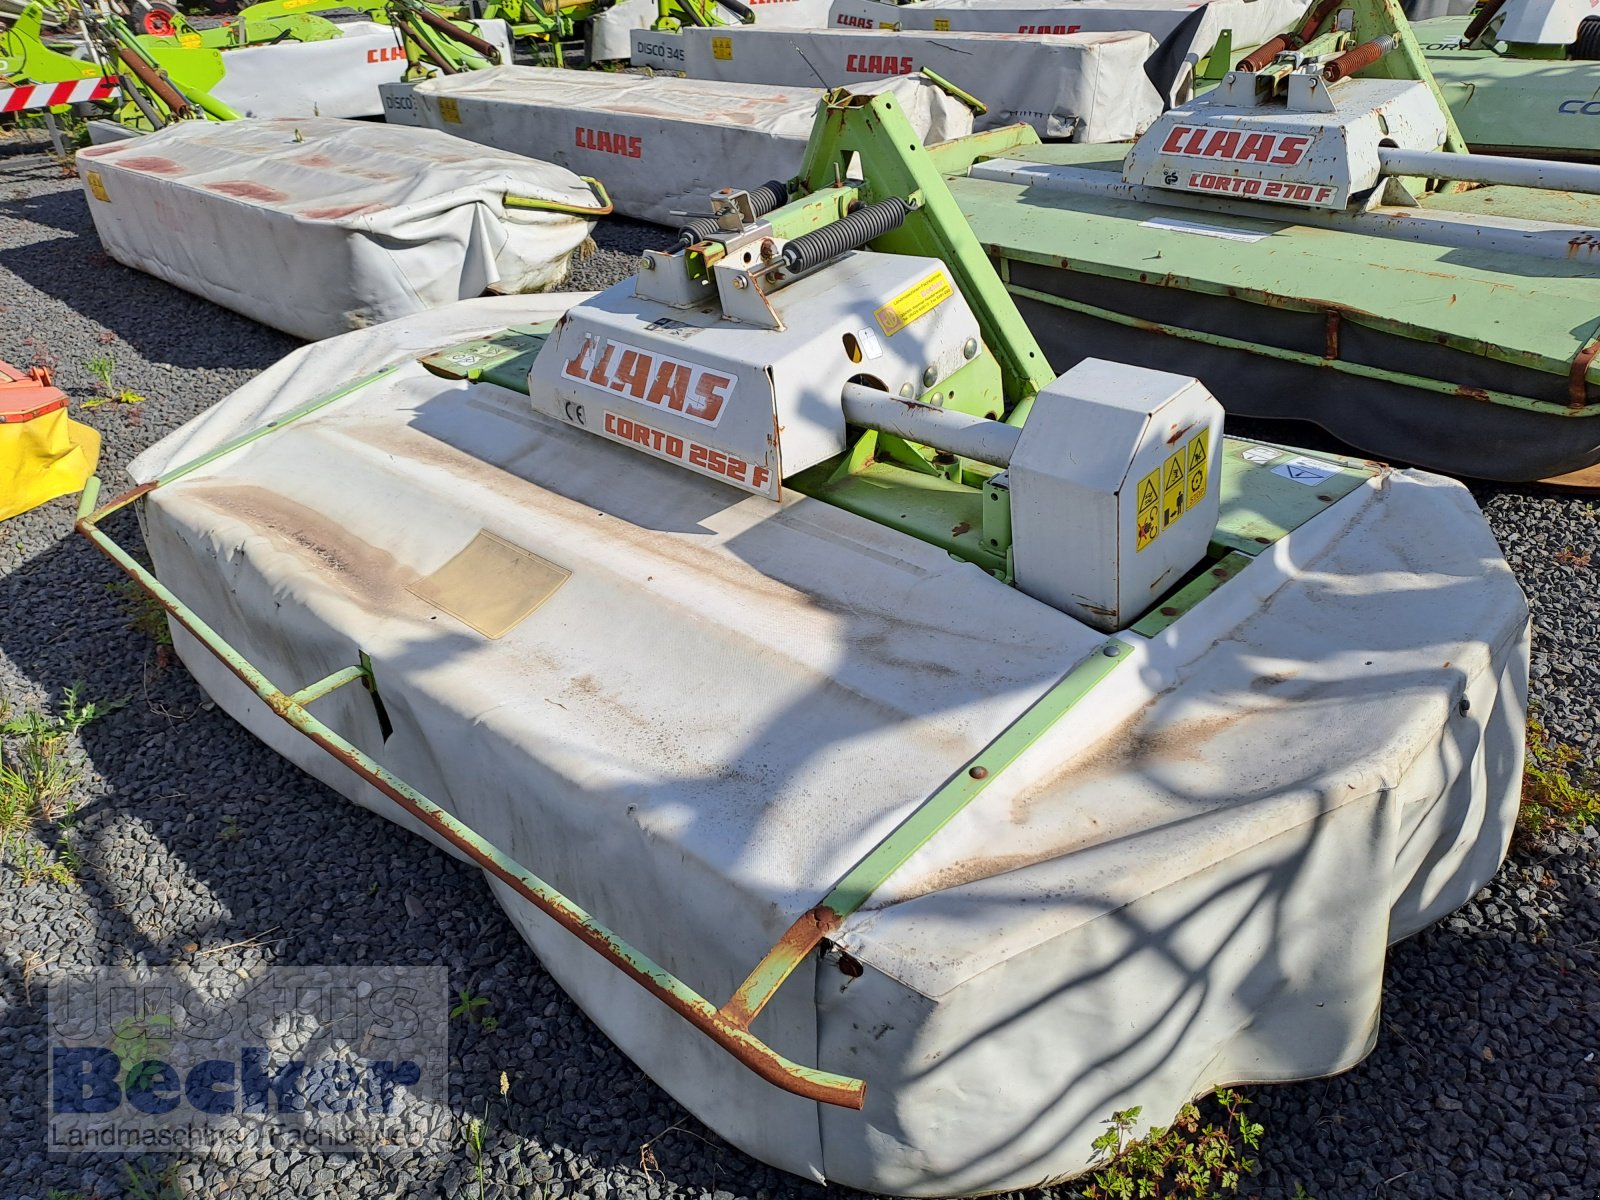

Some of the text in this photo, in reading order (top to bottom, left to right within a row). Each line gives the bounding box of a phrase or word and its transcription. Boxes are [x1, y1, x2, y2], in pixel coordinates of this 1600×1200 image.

[837, 13, 873, 30] CLAAS
[637, 41, 686, 61] DISCO 345
[846, 54, 913, 75] CLAAS
[575, 126, 642, 159] CLAAS
[1161, 126, 1309, 165] CLAAS
[1188, 173, 1332, 203] CORTO 270 F
[604, 412, 770, 489] CORTO 252 F
